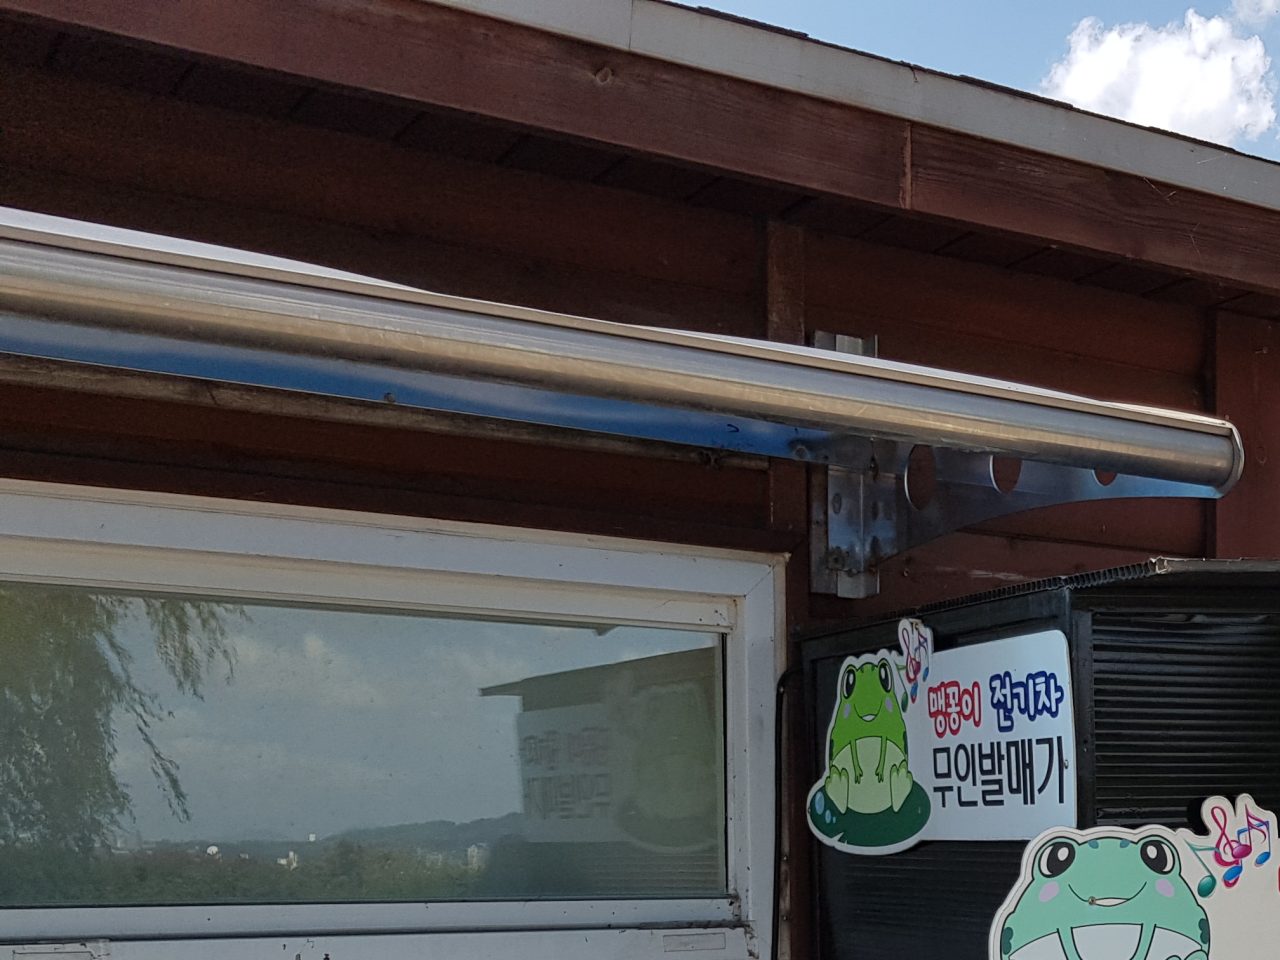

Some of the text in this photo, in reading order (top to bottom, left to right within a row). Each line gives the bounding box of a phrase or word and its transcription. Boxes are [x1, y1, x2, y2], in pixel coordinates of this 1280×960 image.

[927, 671, 1064, 738] 맹꽁이 전기차
[932, 736, 1065, 808] 무인발매기
